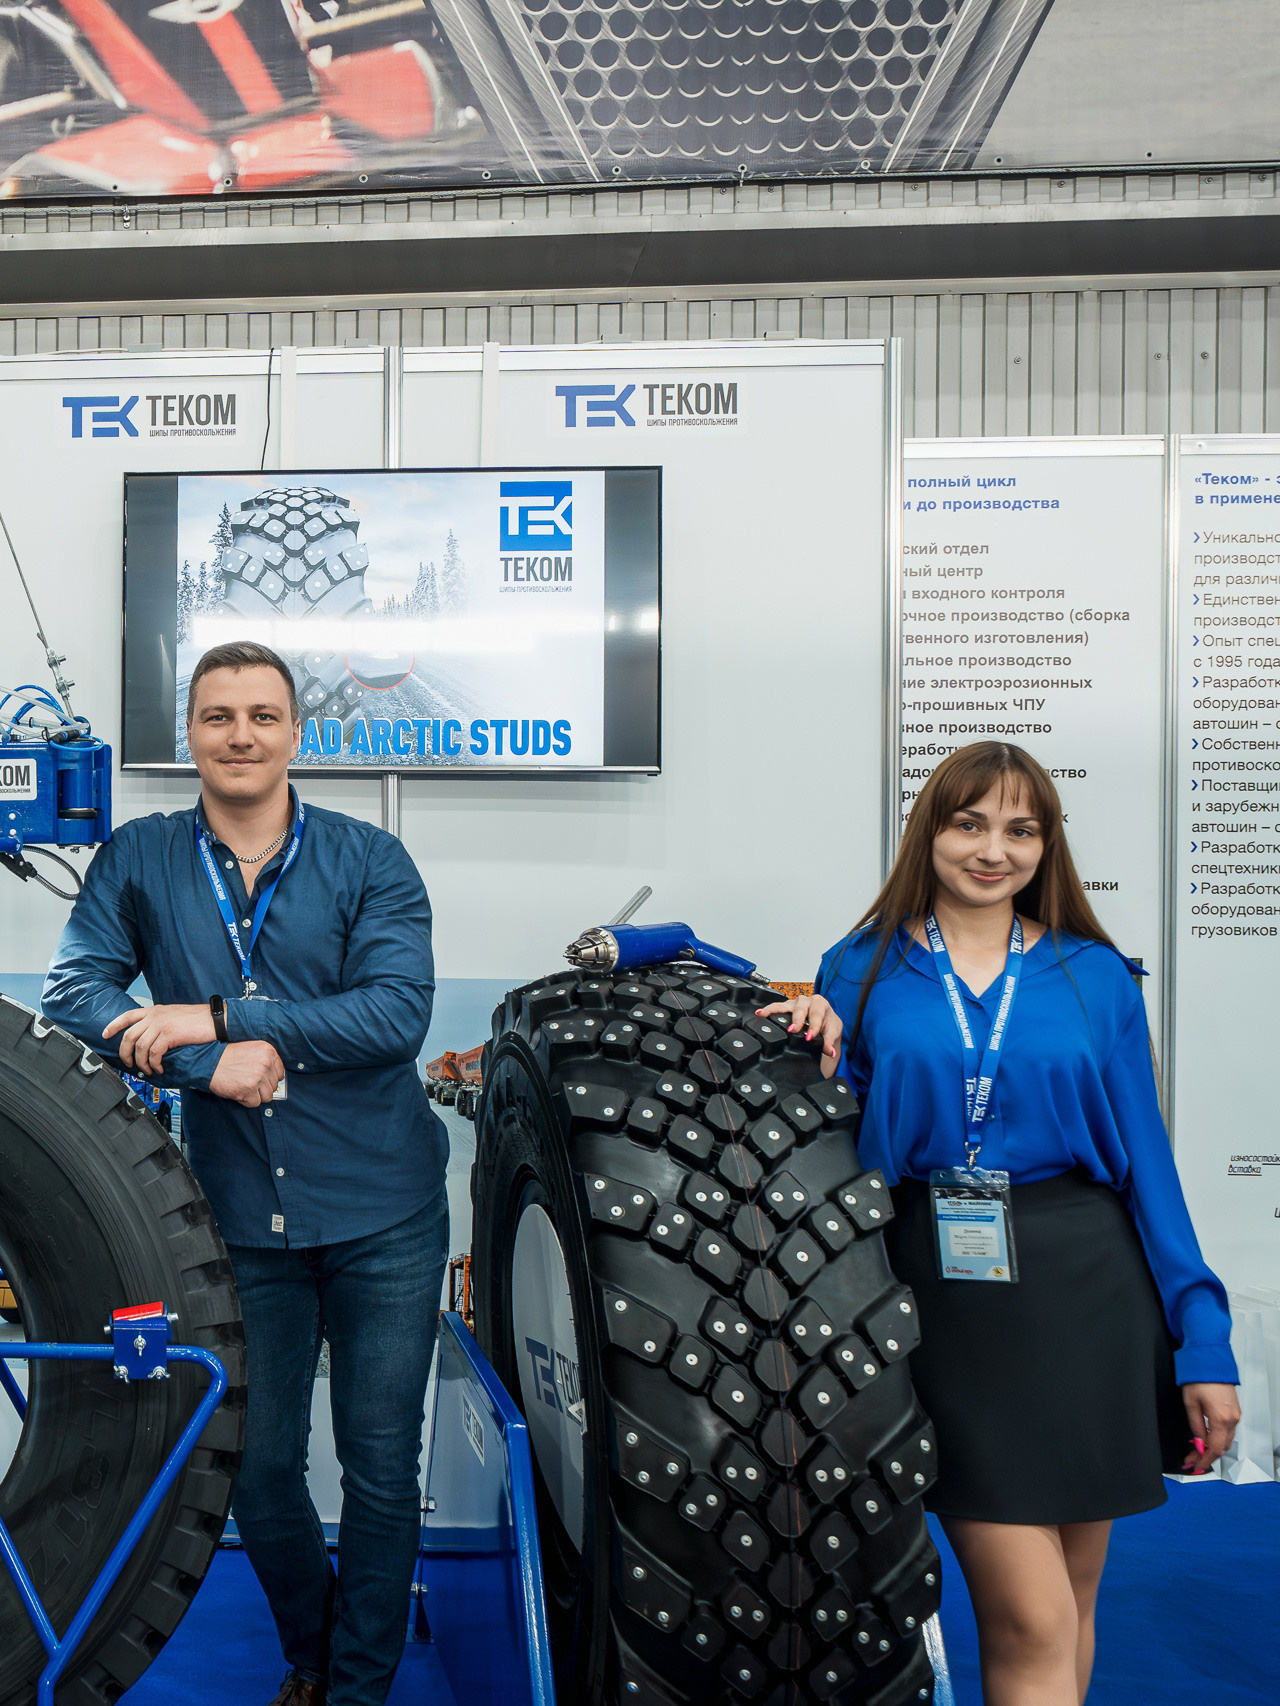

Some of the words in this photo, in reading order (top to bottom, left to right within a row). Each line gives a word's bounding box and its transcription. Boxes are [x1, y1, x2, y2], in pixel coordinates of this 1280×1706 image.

[642, 382, 738, 416] ТЕКОМ
[145, 393, 237, 427] ТЕКОМ
[647, 418, 665, 427] ШИПЫ
[668, 417, 738, 427] ПРОТИВОСКОЛЬЖЕНИЯ
[149, 429, 167, 437] ШИПЫ
[169, 427, 236, 437] ПРОТИВОСКОЛЬЖЕНИЯ
[907, 475, 971, 488] полный
[976, 477, 1016, 489] цикл
[1194, 472, 1259, 485] «Теком»
[916, 500, 937, 512] до
[942, 499, 1060, 513] производства
[1194, 495, 1204, 505] в
[942, 544, 989, 557] отдел
[500, 556, 573, 582] ТЕКОМ
[937, 567, 984, 580] центр
[1193, 575, 1221, 588] для
[911, 589, 986, 602] входного
[991, 589, 1065, 602] контроля
[951, 611, 1065, 625] производство
[1069, 608, 1130, 624] (сборка
[974, 630, 1089, 647] изготовления)
[1202, 634, 1244, 647] Опыт
[958, 656, 1072, 670] производство
[1207, 655, 1243, 668] 1995
[930, 678, 1093, 692] электроэрозионных
[1012, 698, 1046, 711] ЧПУ
[938, 723, 1052, 736] производство
[1192, 719, 1258, 730] автошин
[349, 717, 463, 756] ARCTIC
[470, 718, 573, 756] STUDS
[1192, 802, 1201, 812] и
[1191, 822, 1257, 833] автошин
[1191, 925, 1278, 939] грузовиков
[1227, 1164, 1262, 1174] вставка
